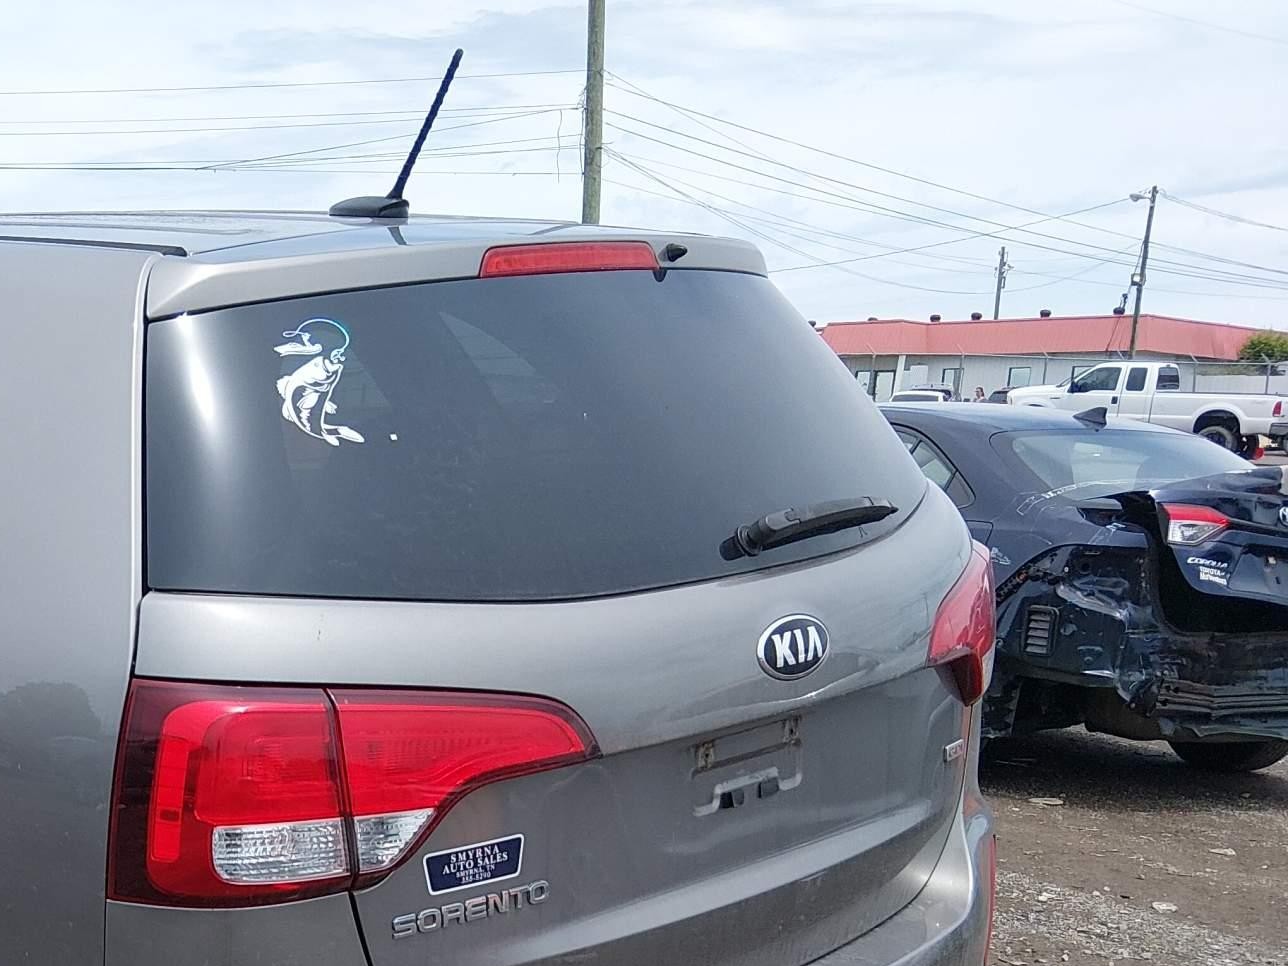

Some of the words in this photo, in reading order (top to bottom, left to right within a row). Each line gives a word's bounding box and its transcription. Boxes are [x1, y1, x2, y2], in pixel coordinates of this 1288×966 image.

[771, 625, 823, 668] KIA
[442, 860, 474, 875] AUTO
[477, 852, 508, 867] SALES
[450, 844, 499, 863] SMYRNA
[392, 880, 550, 939] SORENTO
